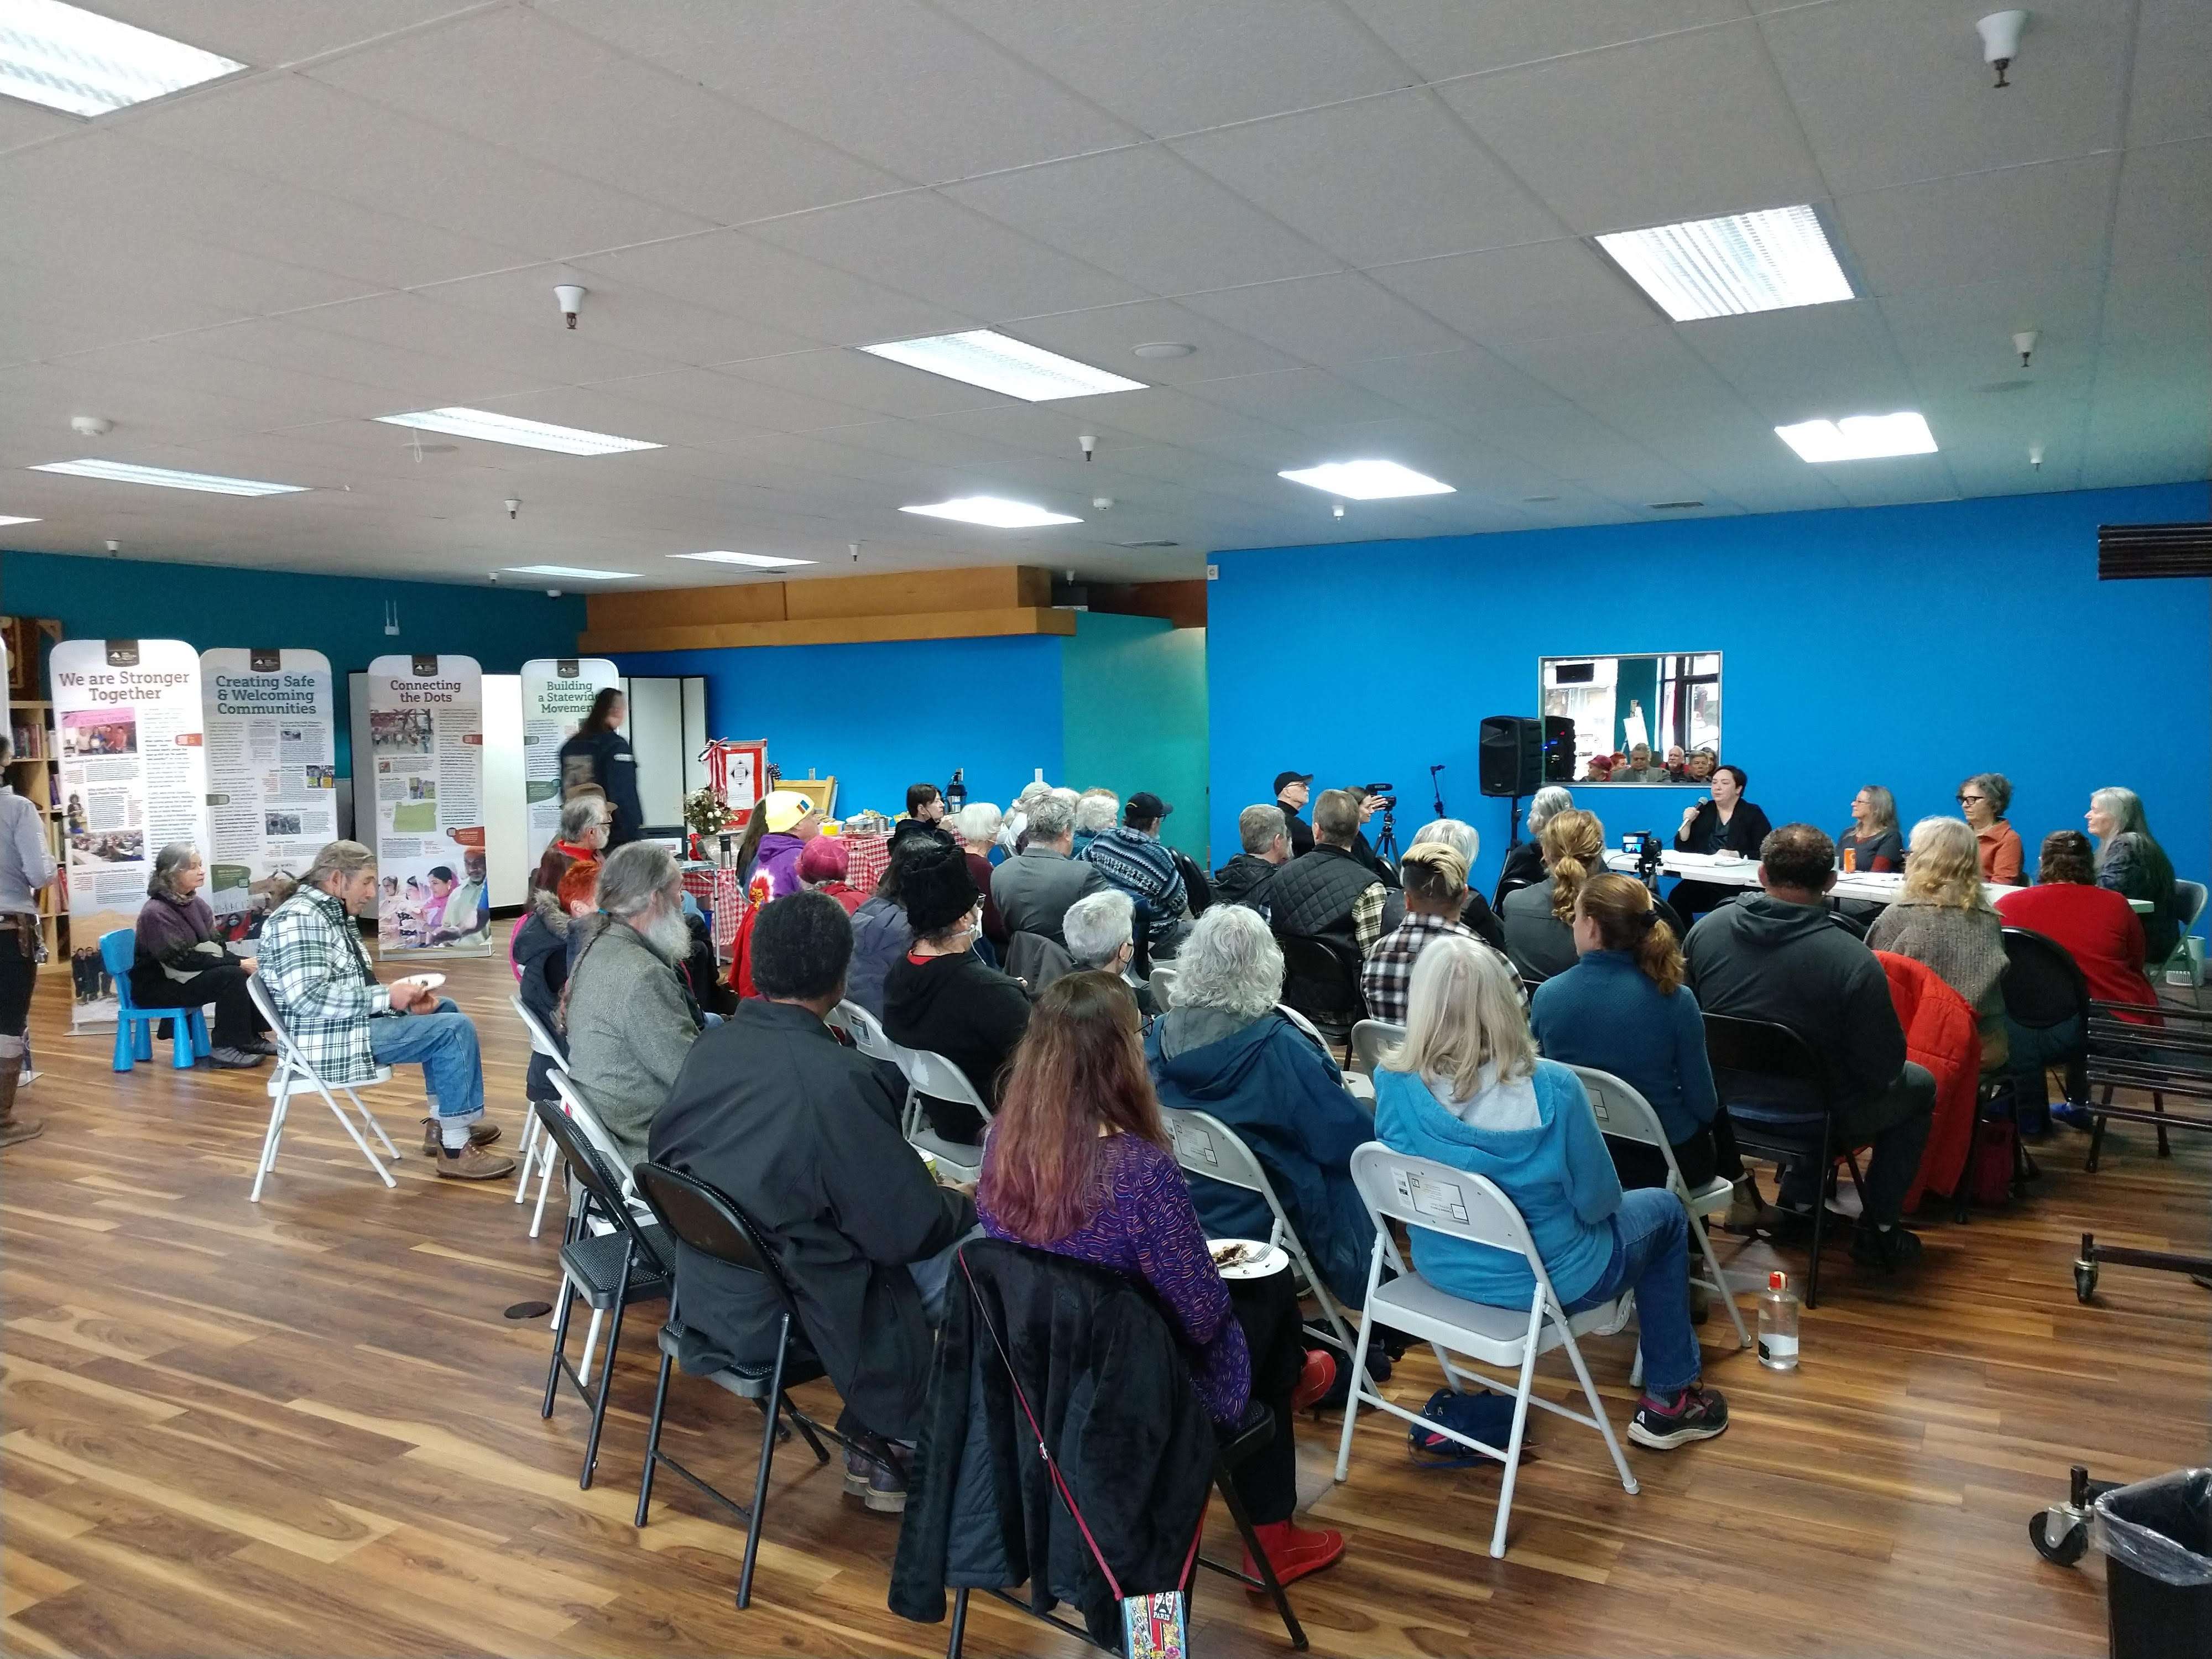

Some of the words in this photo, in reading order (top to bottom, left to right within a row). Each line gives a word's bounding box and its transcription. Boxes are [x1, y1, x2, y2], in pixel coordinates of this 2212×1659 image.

[58, 673, 84, 686] We
[89, 675, 114, 685] are
[119, 671, 190, 687] Stronger
[216, 676, 279, 690] Creating
[284, 676, 315, 687] Safe
[390, 680, 461, 692] Connecting
[546, 681, 592, 692] Building
[89, 687, 161, 703] Together
[217, 690, 227, 700] &
[232, 690, 314, 703] Welcoming
[400, 693, 420, 702] the
[424, 692, 452, 702] Dots
[217, 703, 316, 714] Communities
[541, 703, 593, 713] Movemen
[1153, 1611, 1171, 1621] PARIS
